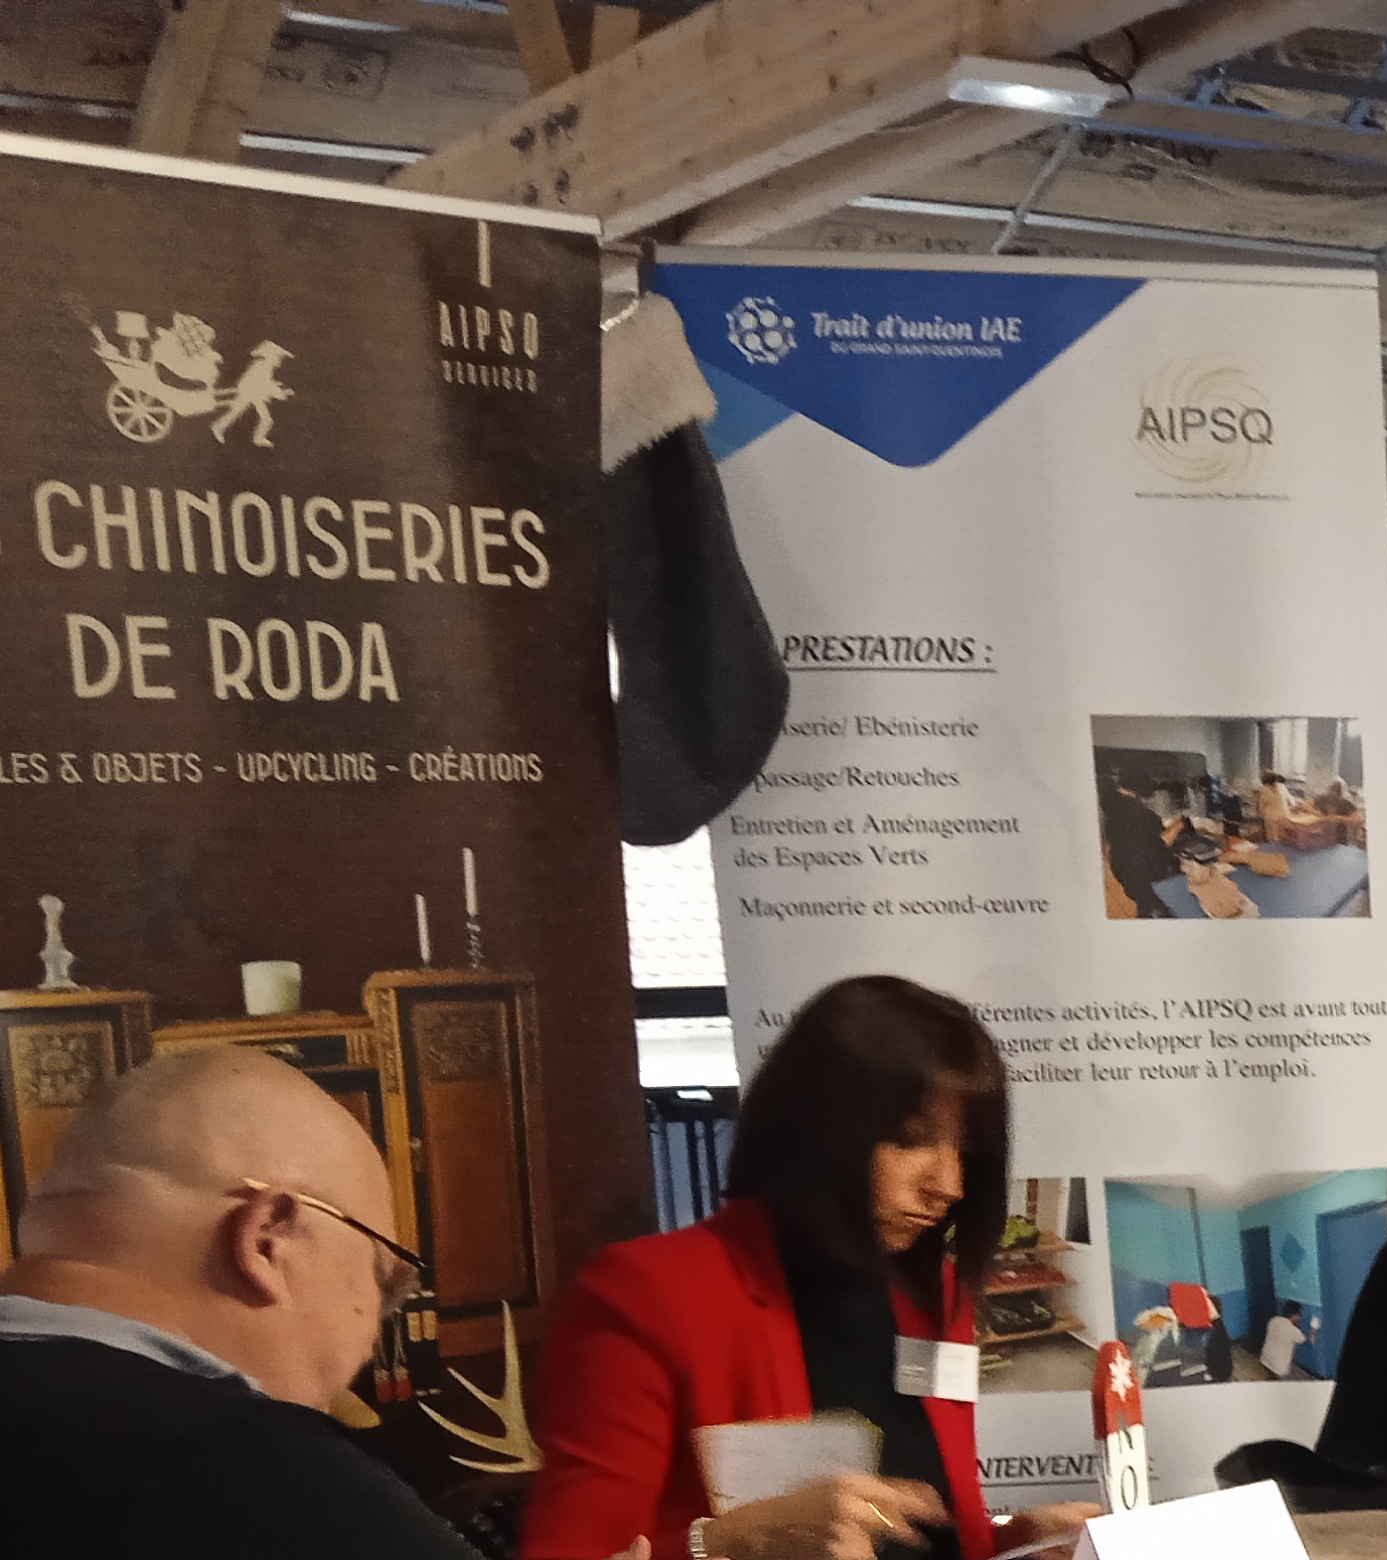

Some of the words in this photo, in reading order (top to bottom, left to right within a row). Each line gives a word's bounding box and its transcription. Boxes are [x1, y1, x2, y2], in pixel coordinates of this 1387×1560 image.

[811, 311, 870, 338] Trait
[876, 313, 973, 341] d'union
[980, 315, 1023, 342] IAE
[1135, 406, 1274, 446] AIPSQ
[34, 480, 550, 589] CHINOISERIES
[66, 613, 176, 700] DE
[208, 617, 400, 702] RODA
[783, 634, 976, 664] PRESTATIONS
[92, 752, 203, 784] OBJETS
[236, 751, 377, 783] UPCYCLING
[410, 746, 543, 783] CRÉATIONS
[755, 766, 960, 793] passage/Retouches
[730, 815, 828, 836] Entretien
[834, 816, 855, 835] et
[862, 813, 1020, 839] Aménagement
[733, 848, 768, 868] des
[775, 846, 863, 872] Espaces
[869, 845, 930, 866] Verts
[738, 896, 865, 922] Maçonnerie
[873, 898, 895, 916] et
[1061, 1000, 1159, 1022] activités,
[1163, 998, 1252, 1022] l'AIPSQ
[1258, 1003, 1288, 1019] est
[1293, 1002, 1347, 1019] avant
[1059, 1037, 1079, 1052] et
[1087, 1032, 1202, 1059] développer
[1209, 1029, 1240, 1049] les
[1244, 1030, 1372, 1056] compétences
[1091, 1062, 1131, 1082] leur
[1138, 1062, 1201, 1081] retour
[1204, 1058, 1220, 1078] à
[1224, 1056, 1317, 1084] l'emploi.
[977, 1452, 1099, 1479] NTERVENT
